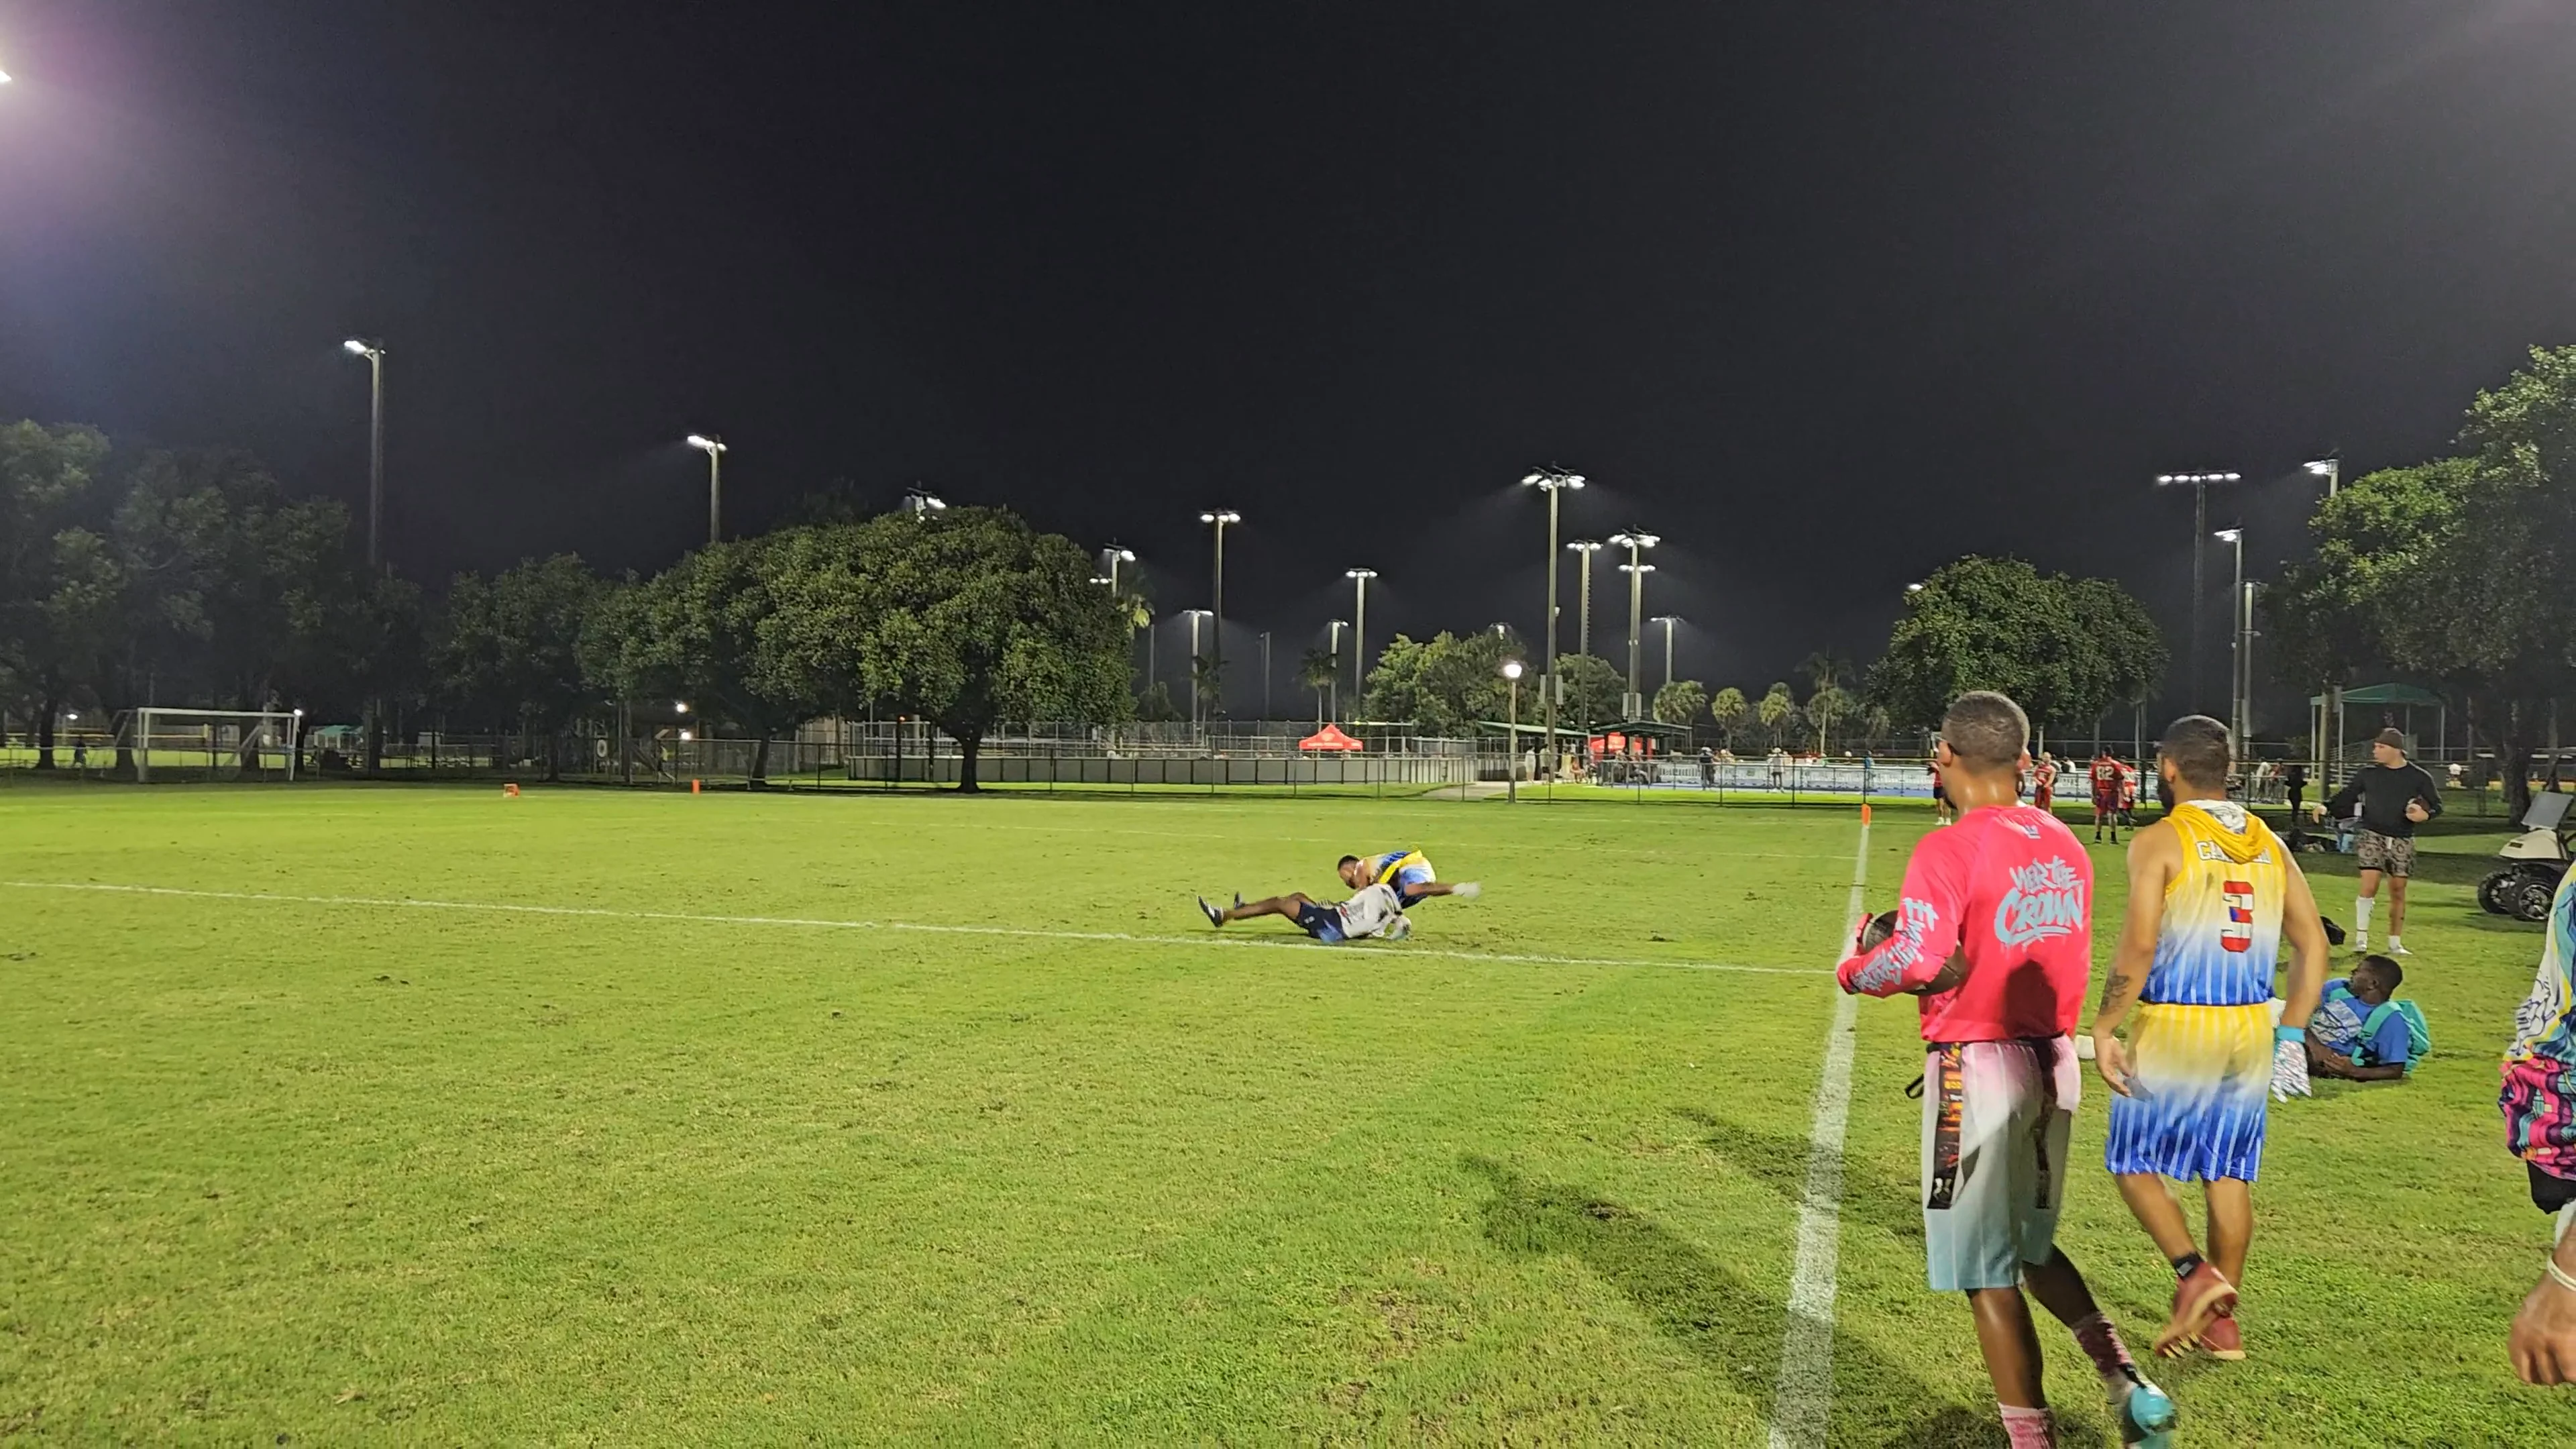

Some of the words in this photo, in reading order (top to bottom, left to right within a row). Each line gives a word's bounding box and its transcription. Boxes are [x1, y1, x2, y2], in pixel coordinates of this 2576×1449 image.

[2096, 765, 2114, 780] 82
[1994, 879, 2085, 945] CROWN
[2220, 880, 2253, 952] 3
